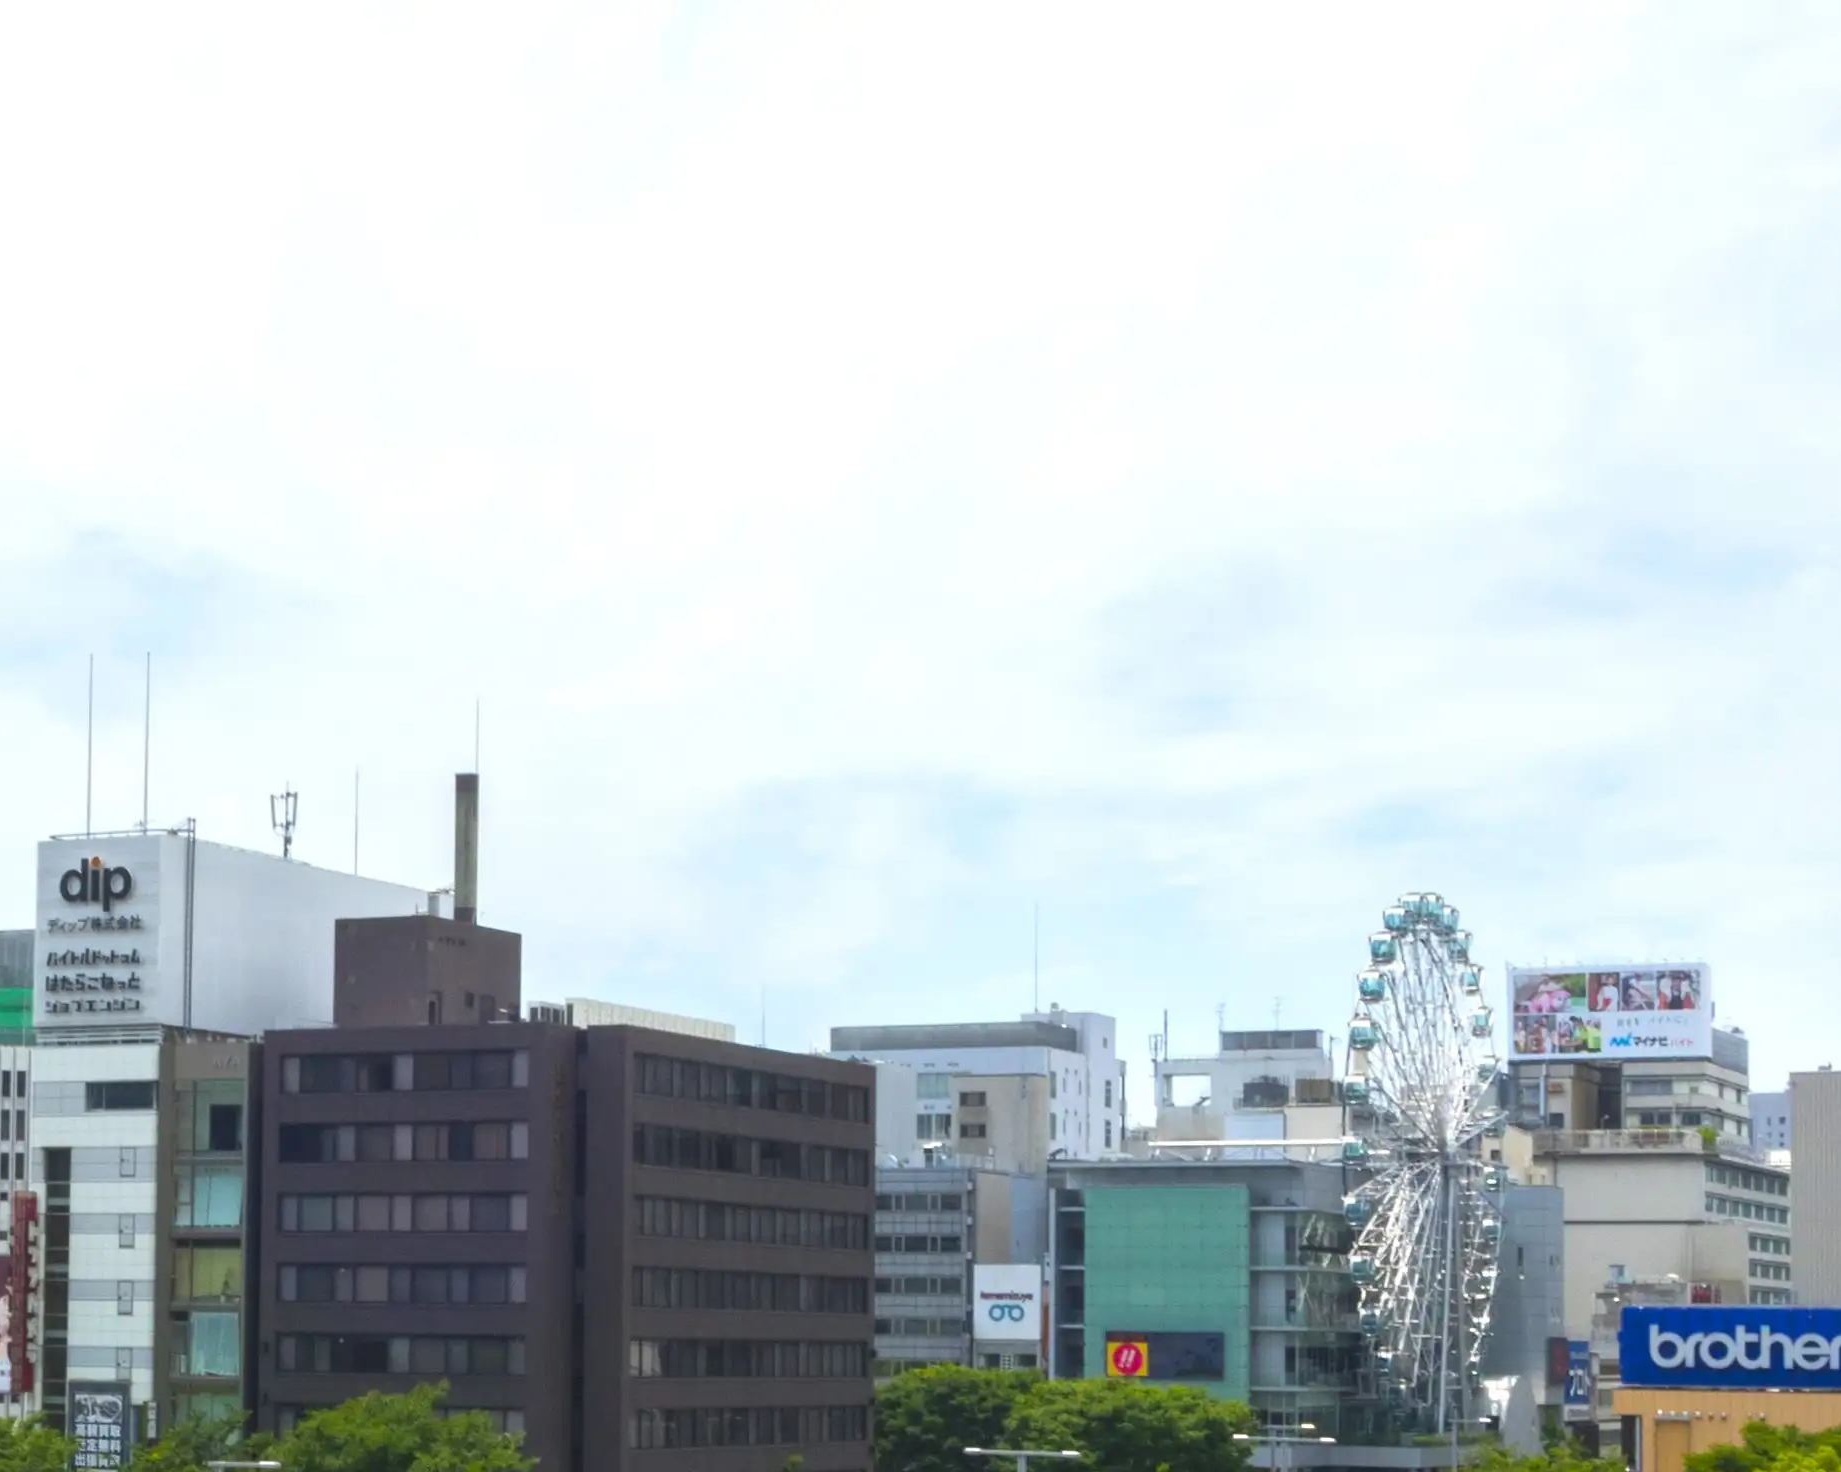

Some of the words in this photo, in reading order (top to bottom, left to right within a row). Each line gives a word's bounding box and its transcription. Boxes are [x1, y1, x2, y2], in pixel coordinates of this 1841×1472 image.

[59, 856, 133, 913] dip
[47, 914, 143, 934] ディップ株式会社
[46, 948, 142, 967] バイトルドットコム
[45, 972, 142, 993] はたらこねっと
[45, 999, 141, 1014] ジョブエンジン
[1649, 1324, 1841, 1371] brother
